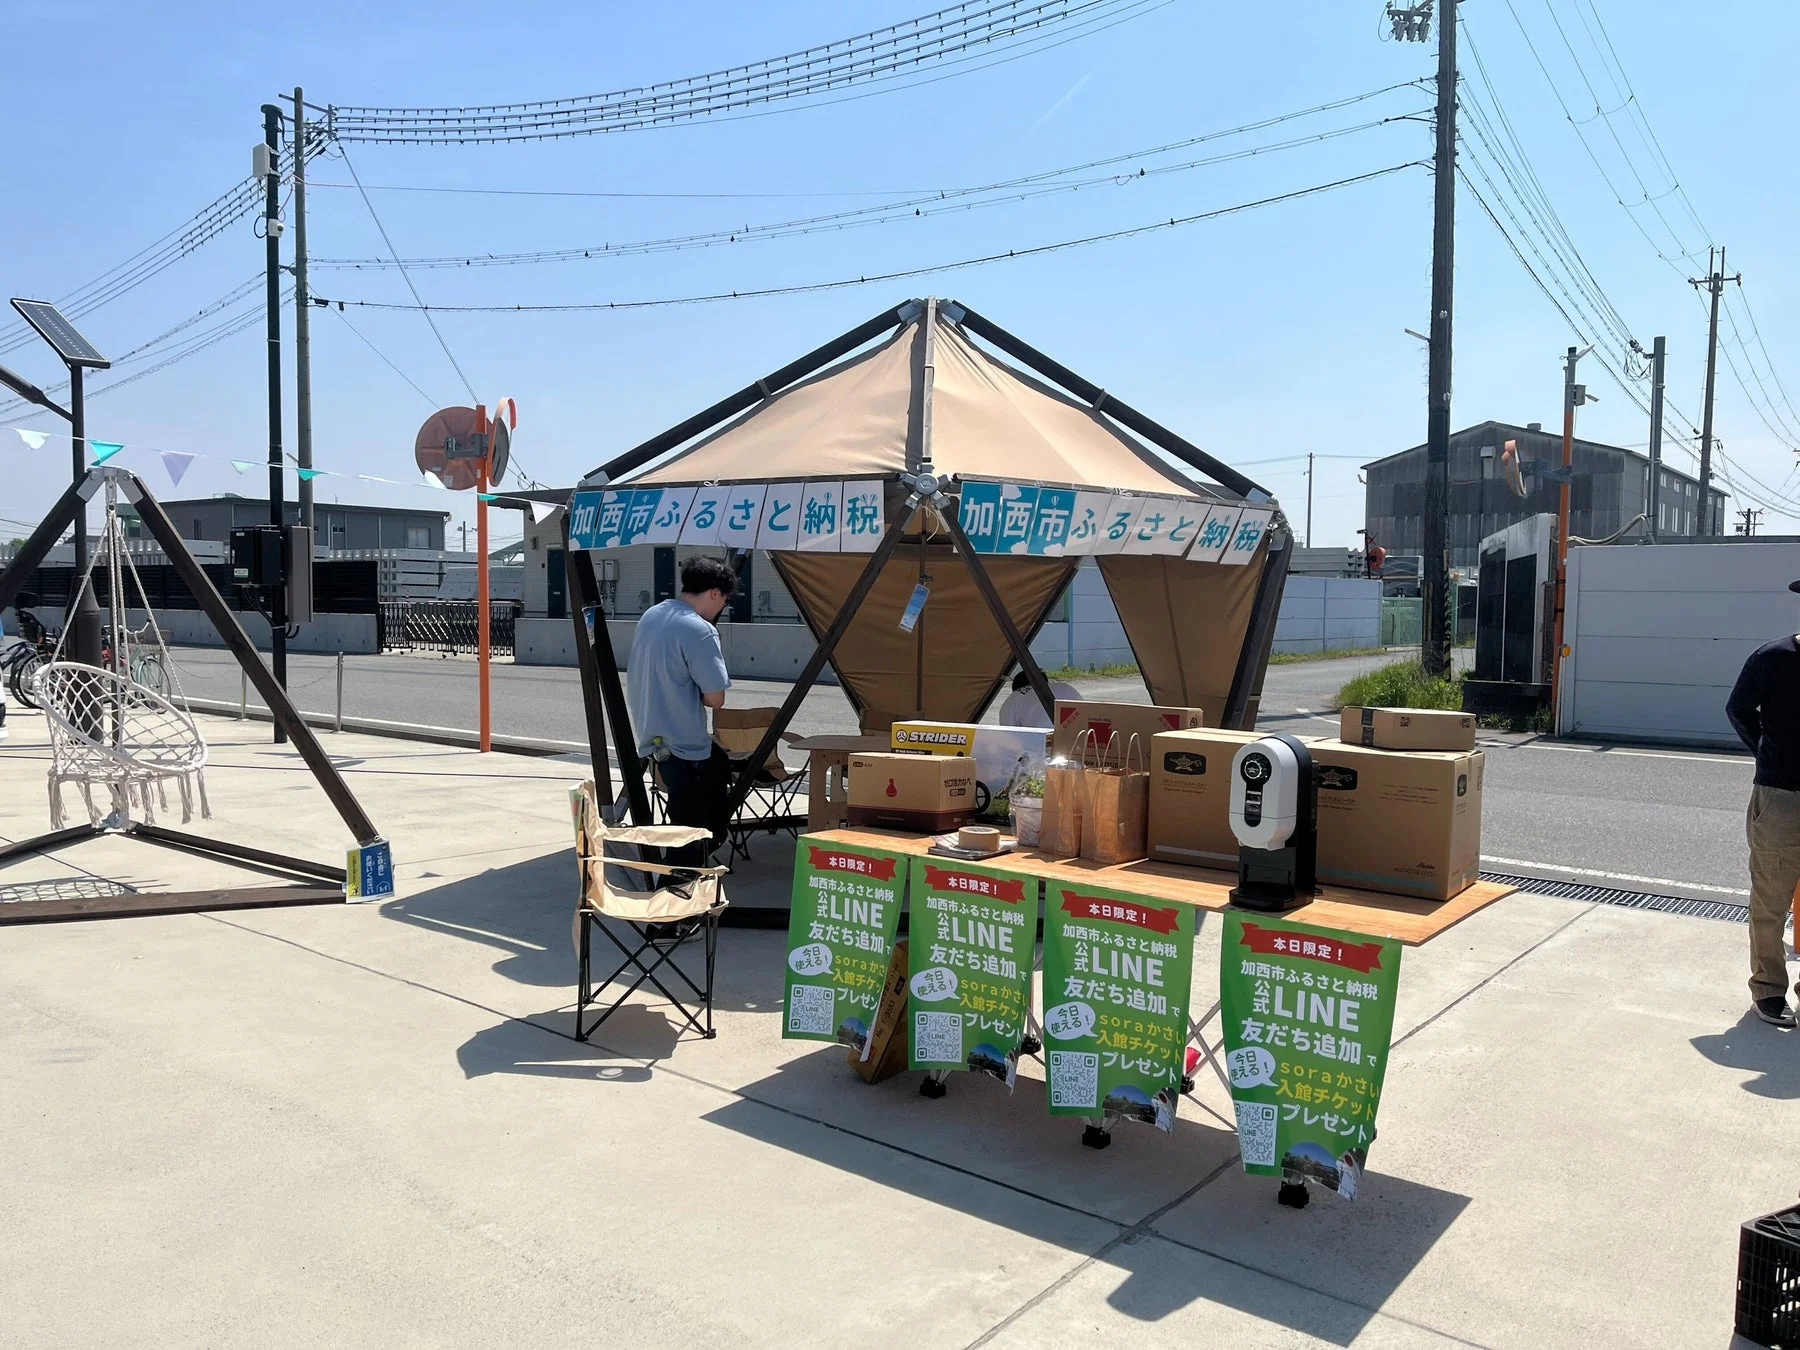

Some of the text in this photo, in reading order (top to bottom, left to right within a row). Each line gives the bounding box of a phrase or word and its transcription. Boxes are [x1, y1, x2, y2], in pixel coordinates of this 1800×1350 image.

[571, 493, 880, 536] 加西市ふるさと納税
[963, 496, 1261, 552] 加西市ふるさと納税
[909, 731, 967, 745] STRIDER
[829, 856, 873, 874] 本日限定！
[808, 875, 894, 903] 加西市ふるさと納税
[948, 876, 998, 895] 本日限定！
[816, 890, 884, 929] 公式 LINE
[926, 896, 1025, 927] 加西市ふるさと納税
[1088, 903, 1147, 924] 本日限定！
[937, 912, 1014, 953] 公式 LINE
[1062, 923, 1178, 959] 加西市ふるさと納税
[802, 946, 821, 958] 今日
[929, 943, 1026, 982] 友だち追加で
[1074, 941, 1164, 988] 公式 LINE
[1273, 938, 1343, 961] 本日限定！
[832, 968, 882, 994] 入館チケッ
[834, 954, 886, 977] soraかさ
[924, 970, 944, 982] 今日
[1240, 959, 1378, 1000] 加西市ふるさと納税
[805, 1005, 819, 1013] LINE
[836, 987, 878, 1011] プレゼン
[1057, 1005, 1079, 1018] 今日
[1063, 975, 1181, 1018] 友だち追加で
[1253, 980, 1360, 1033] 公式 LINE
[964, 1012, 1021, 1044] プレゼント
[1240, 1017, 1377, 1068] 友だち追加で
[1096, 1029, 1182, 1065] 入館チケット
[1235, 1050, 1257, 1065] 今日
[1064, 1075, 1079, 1083] LINE
[1102, 1051, 1177, 1084] プレゼント
[1275, 1079, 1374, 1122] 入館チケット
[1282, 1103, 1367, 1144] プレゼント
